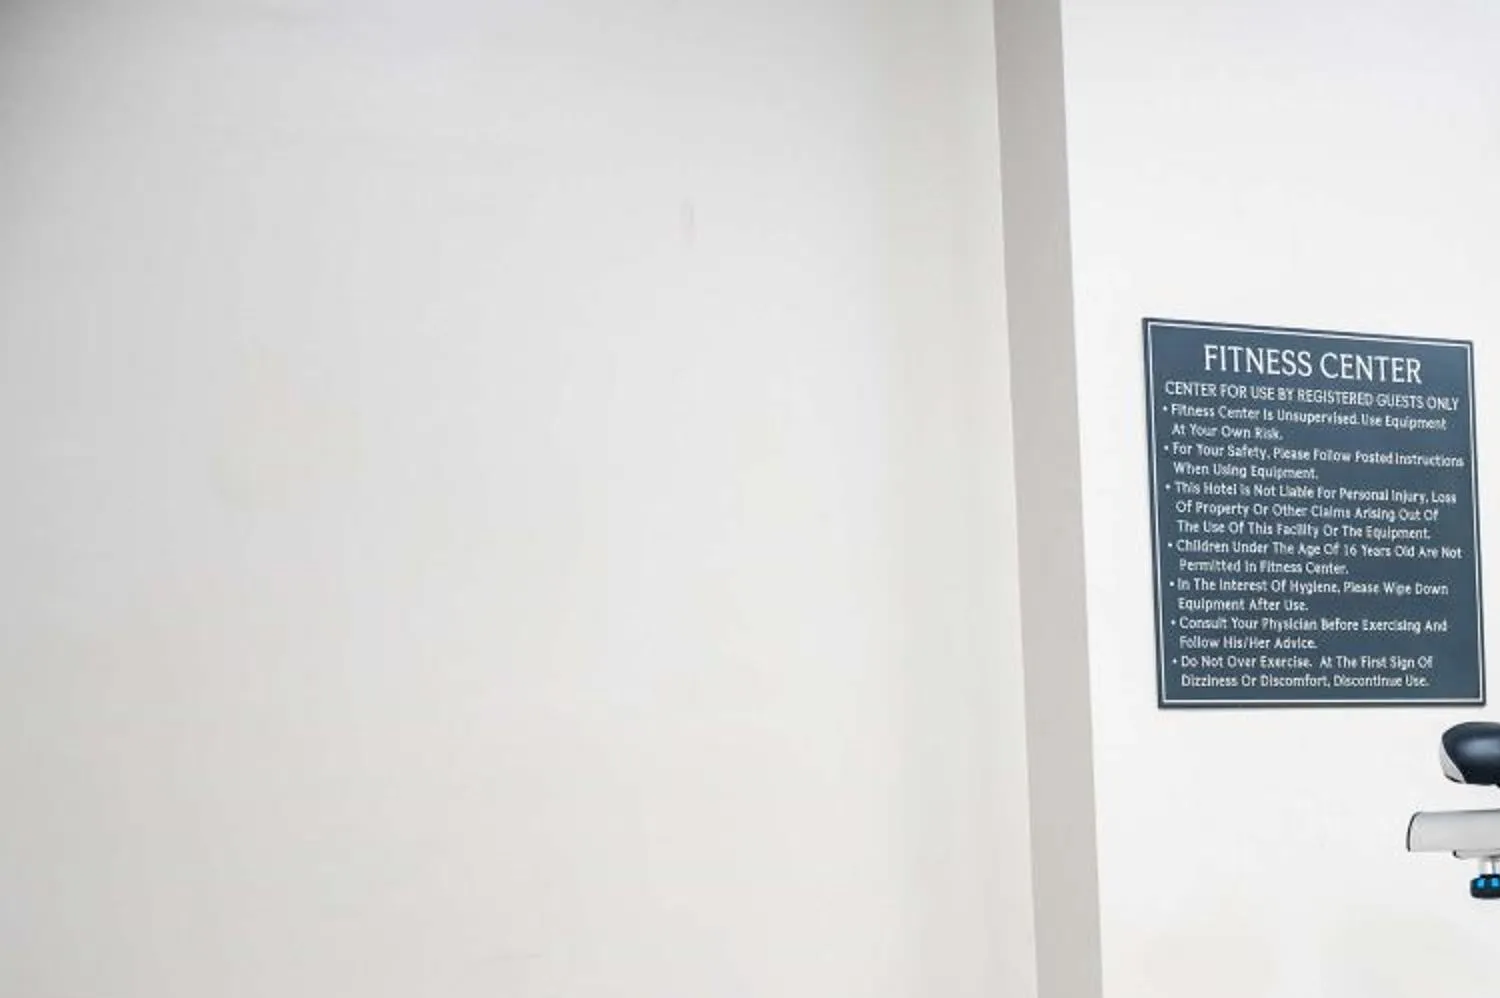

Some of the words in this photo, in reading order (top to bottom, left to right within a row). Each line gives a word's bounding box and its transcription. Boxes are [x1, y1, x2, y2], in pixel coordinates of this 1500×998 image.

[1203, 343, 1312, 377] FITNESS
[1319, 351, 1422, 384] CENTER
[1164, 380, 1216, 397] CENTER
[1219, 383, 1247, 399] FOR
[1250, 385, 1275, 400] USE
[1277, 387, 1294, 401] BY
[1297, 388, 1374, 406] REGISTERED
[1375, 393, 1424, 409] GUESTS
[1425, 395, 1459, 411] ONLY
[1170, 403, 1215, 417] Fitness
[1217, 405, 1260, 420] Center
[1361, 413, 1383, 426] Use
[1384, 414, 1446, 431] Equipment
[1171, 423, 1185, 435] At
[1189, 423, 1218, 437] Your
[1221, 425, 1250, 438] Own
[1171, 441, 1193, 454] For
[1195, 443, 1225, 456] Your
[1272, 446, 1310, 460] Please
[1313, 448, 1351, 461] Follow
[1354, 450, 1393, 464] Posted
[1395, 452, 1464, 467] Instructions
[1173, 461, 1209, 475] When
[1213, 463, 1247, 478] Using
[1174, 481, 1200, 494] This
[1203, 482, 1236, 495] Hotel
[1253, 484, 1276, 496] Not
[1279, 484, 1314, 498] Liable
[1317, 486, 1336, 499] For
[1339, 487, 1388, 501] Personal
[1431, 491, 1456, 503] Loss
[1175, 499, 1192, 512] Of
[1195, 501, 1250, 517] Property
[1252, 503, 1269, 515] Or
[1271, 503, 1308, 517] Other
[1353, 507, 1396, 522] Arising
[1398, 508, 1421, 521] Out
[1423, 508, 1439, 521] Of
[1176, 519, 1199, 532] The
[1203, 520, 1224, 533] Use
[1227, 520, 1244, 534] Of
[1247, 521, 1272, 534] This
[1276, 521, 1318, 538] Facility
[1322, 523, 1338, 536] Or
[1341, 524, 1362, 537] The
[1175, 539, 1229, 552] Children
[1231, 540, 1270, 553] Under
[1271, 541, 1294, 554] The
[1297, 542, 1321, 557] Age
[1322, 542, 1341, 555] Of
[1343, 543, 1358, 556] 16
[1360, 544, 1392, 556] Years
[1393, 544, 1415, 557] Old
[1417, 546, 1439, 558] Are
[1441, 546, 1462, 558] Not
[1179, 558, 1241, 572] Permitted
[1244, 560, 1257, 572] In
[1259, 560, 1302, 573] Fitness
[1177, 578, 1190, 590] In
[1193, 577, 1216, 590] The
[1219, 578, 1267, 591] Interest
[1270, 579, 1286, 592] Of
[1343, 581, 1379, 593] Please
[1382, 581, 1411, 595] Wipe
[1414, 582, 1448, 595] Down
[1177, 597, 1245, 612] Equipment
[1248, 597, 1280, 610] After
[1179, 616, 1227, 629] Consult
[1231, 616, 1258, 629] Your
[1261, 617, 1318, 632] Physician
[1320, 617, 1358, 630] Before
[1361, 619, 1421, 633] Exercising
[1423, 619, 1447, 631] And
[1179, 635, 1220, 648] Follow
[1222, 636, 1271, 648] His/Her
[1181, 655, 1198, 667] Do
[1201, 656, 1223, 667] Not
[1227, 655, 1256, 667] Over
[1319, 656, 1332, 668] At
[1336, 655, 1357, 667] The
[1361, 656, 1387, 668] First
[1389, 656, 1414, 669] Sign
[1417, 656, 1432, 668] Of
[1181, 674, 1238, 686] Dizziness
[1241, 674, 1257, 686] Or
[1333, 674, 1402, 686] Discontinue
